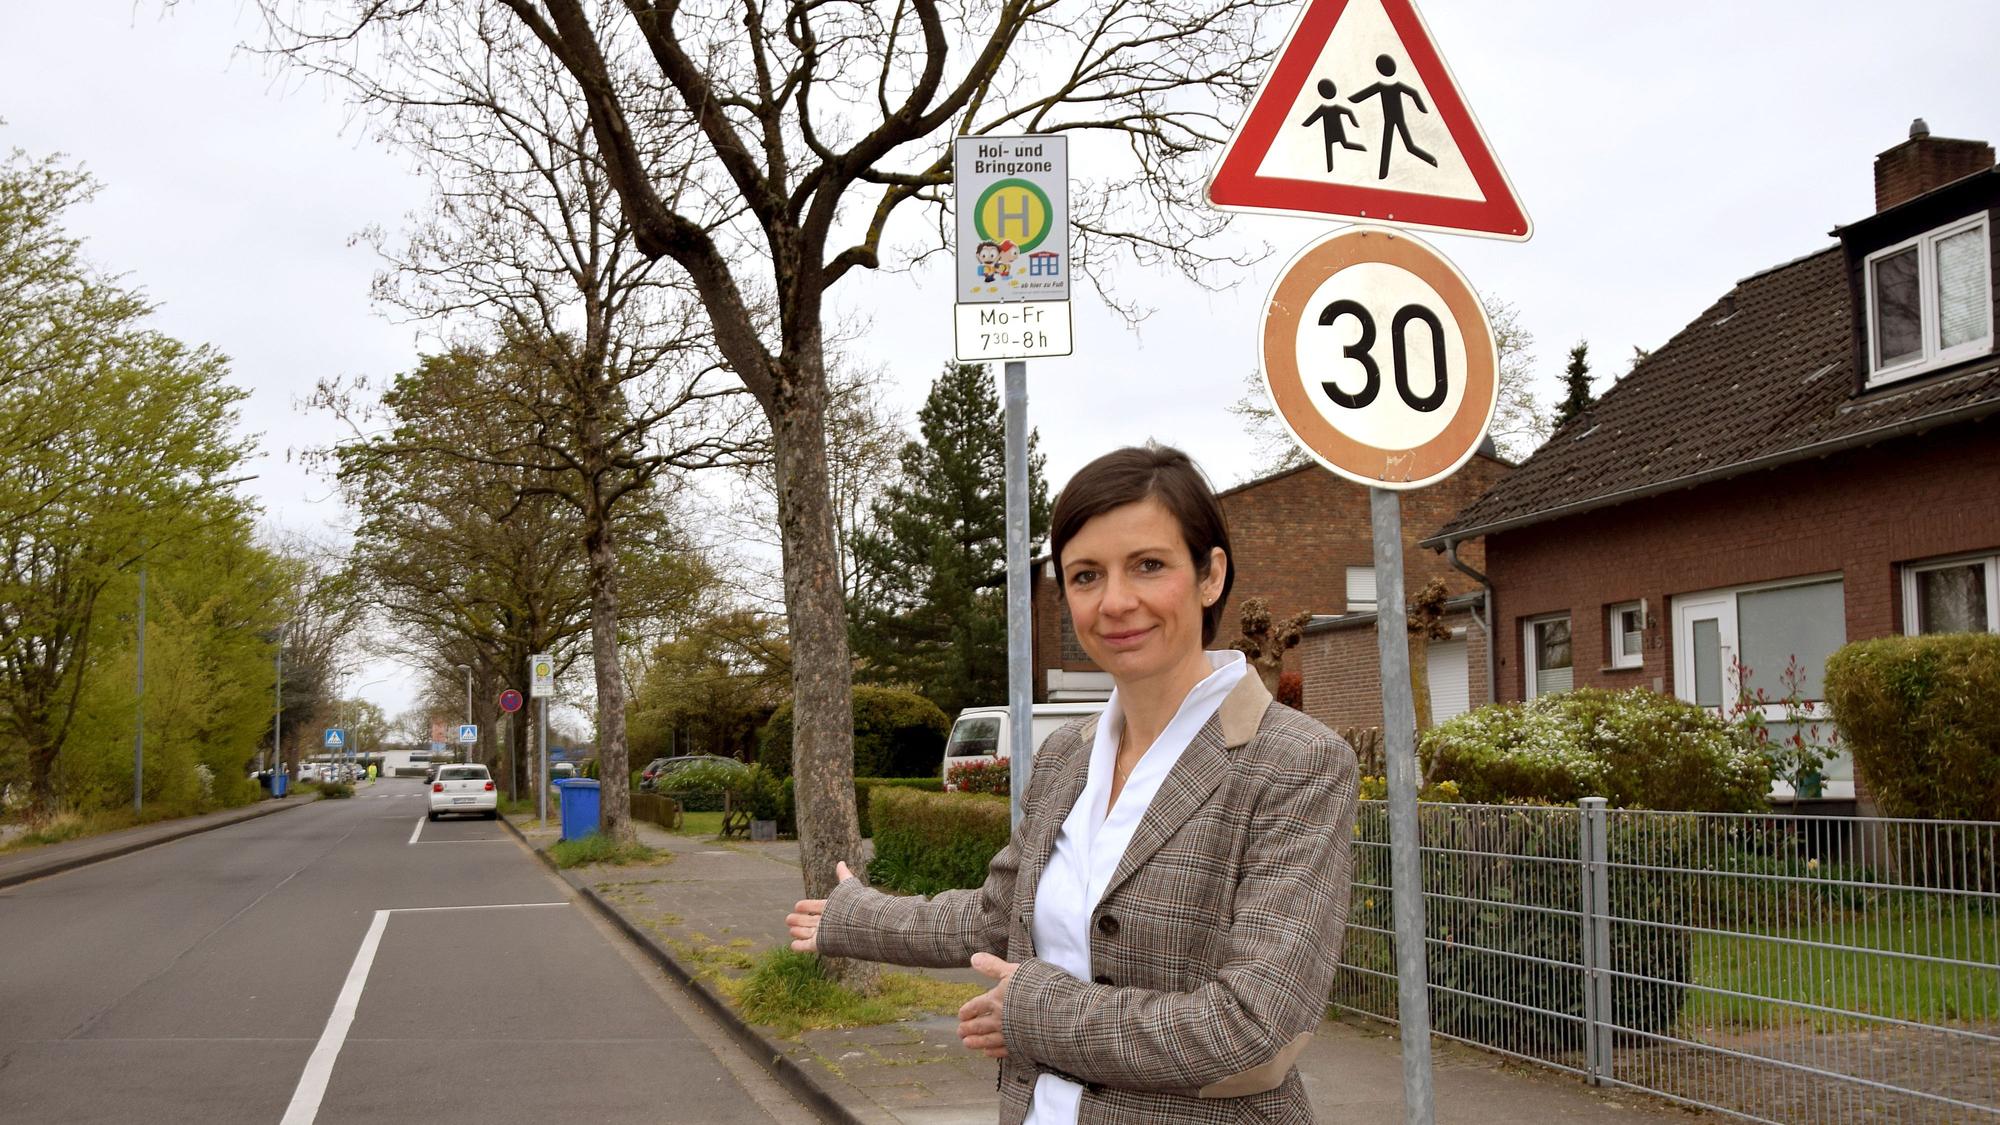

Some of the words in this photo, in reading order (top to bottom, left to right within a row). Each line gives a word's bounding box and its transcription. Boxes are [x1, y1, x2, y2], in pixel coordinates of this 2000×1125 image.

[978, 144, 1009, 158] Hol-
[1015, 143, 1043, 157] und
[975, 160, 1052, 176] Bringzone
[997, 195, 1031, 238] H
[1318, 298, 1449, 413] 30
